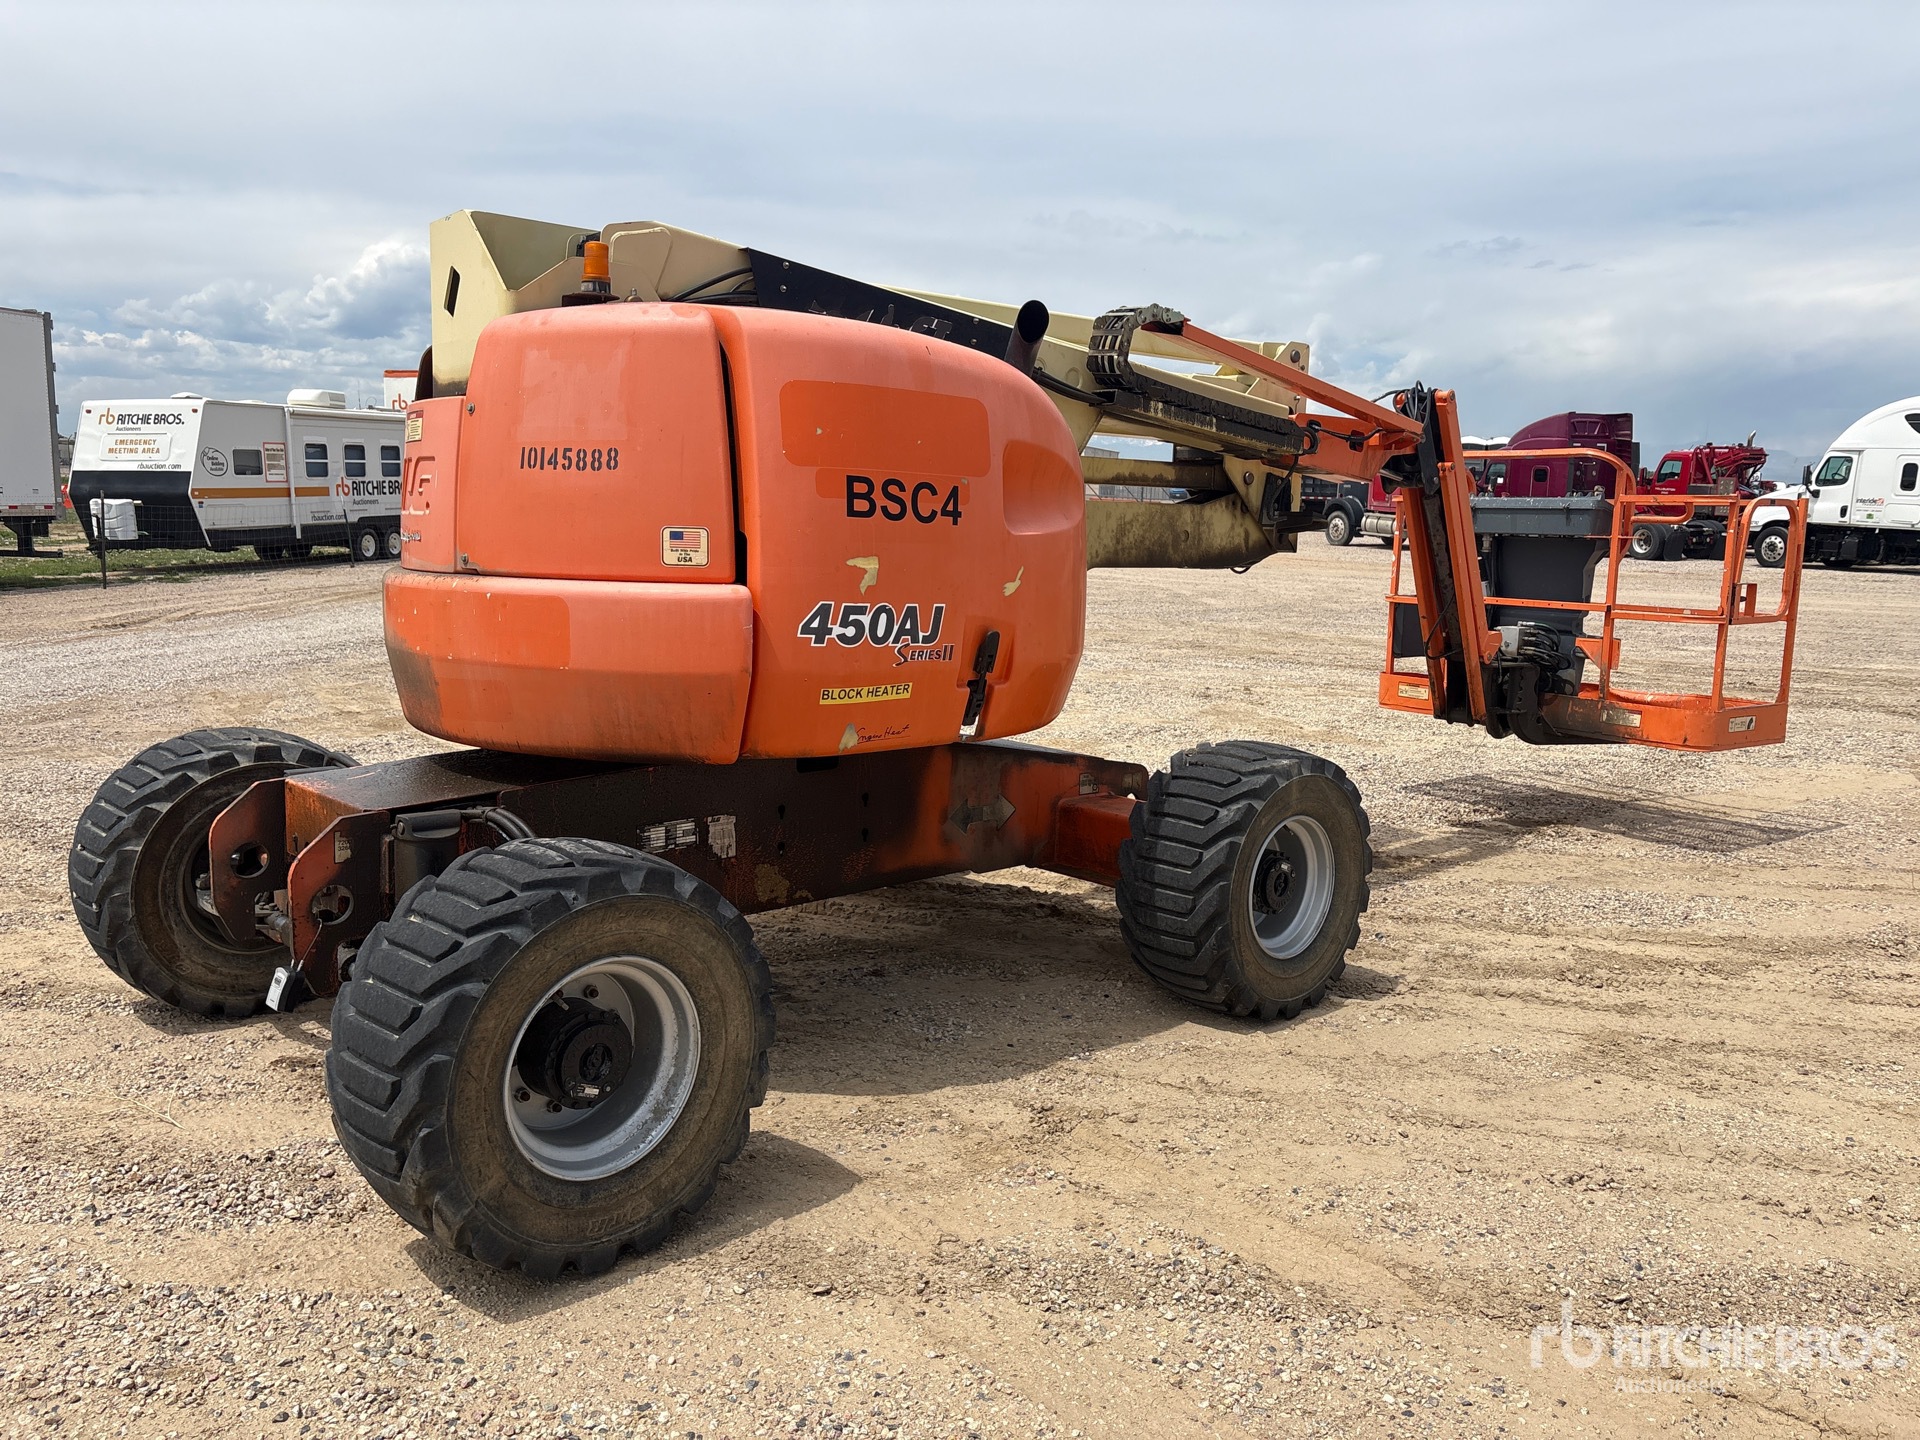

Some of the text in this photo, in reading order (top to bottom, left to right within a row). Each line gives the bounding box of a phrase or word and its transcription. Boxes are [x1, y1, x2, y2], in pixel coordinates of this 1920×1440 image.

[116, 413, 152, 425] RITCHIE
[153, 413, 185, 425] BROS.
[136, 462, 182, 470] rbauction.com
[520, 446, 620, 472] 10145888
[351, 480, 387, 496] RITCHIE
[845, 474, 963, 526] BSC4
[797, 601, 946, 647] 450AJ
[821, 683, 910, 701] BLOCK HEATER
